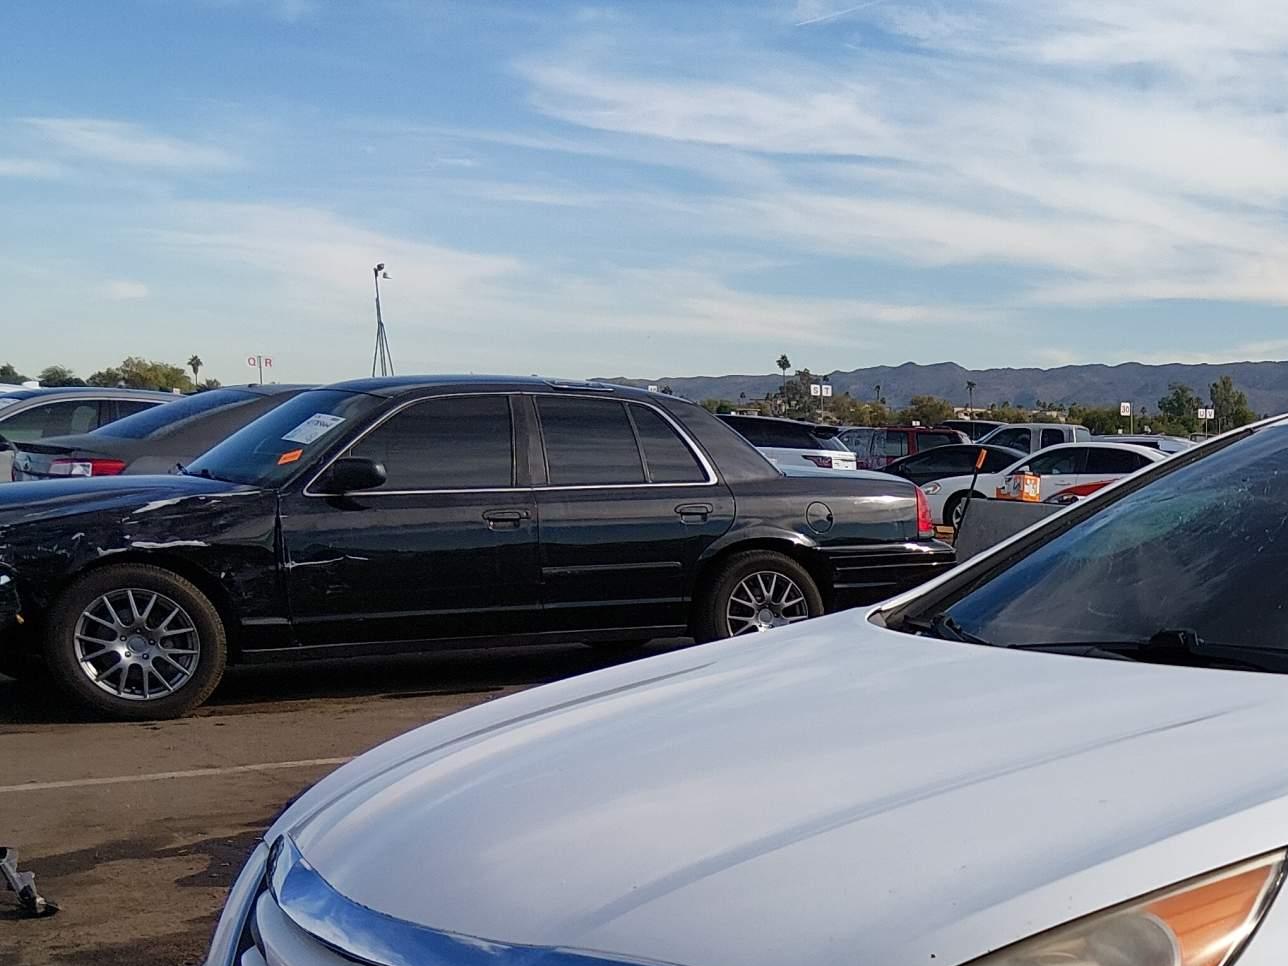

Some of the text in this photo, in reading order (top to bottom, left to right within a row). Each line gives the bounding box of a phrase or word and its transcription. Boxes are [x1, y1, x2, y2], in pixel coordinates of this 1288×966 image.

[247, 356, 256, 367] Q
[264, 357, 273, 368] R
[1121, 405, 1130, 414] 30
